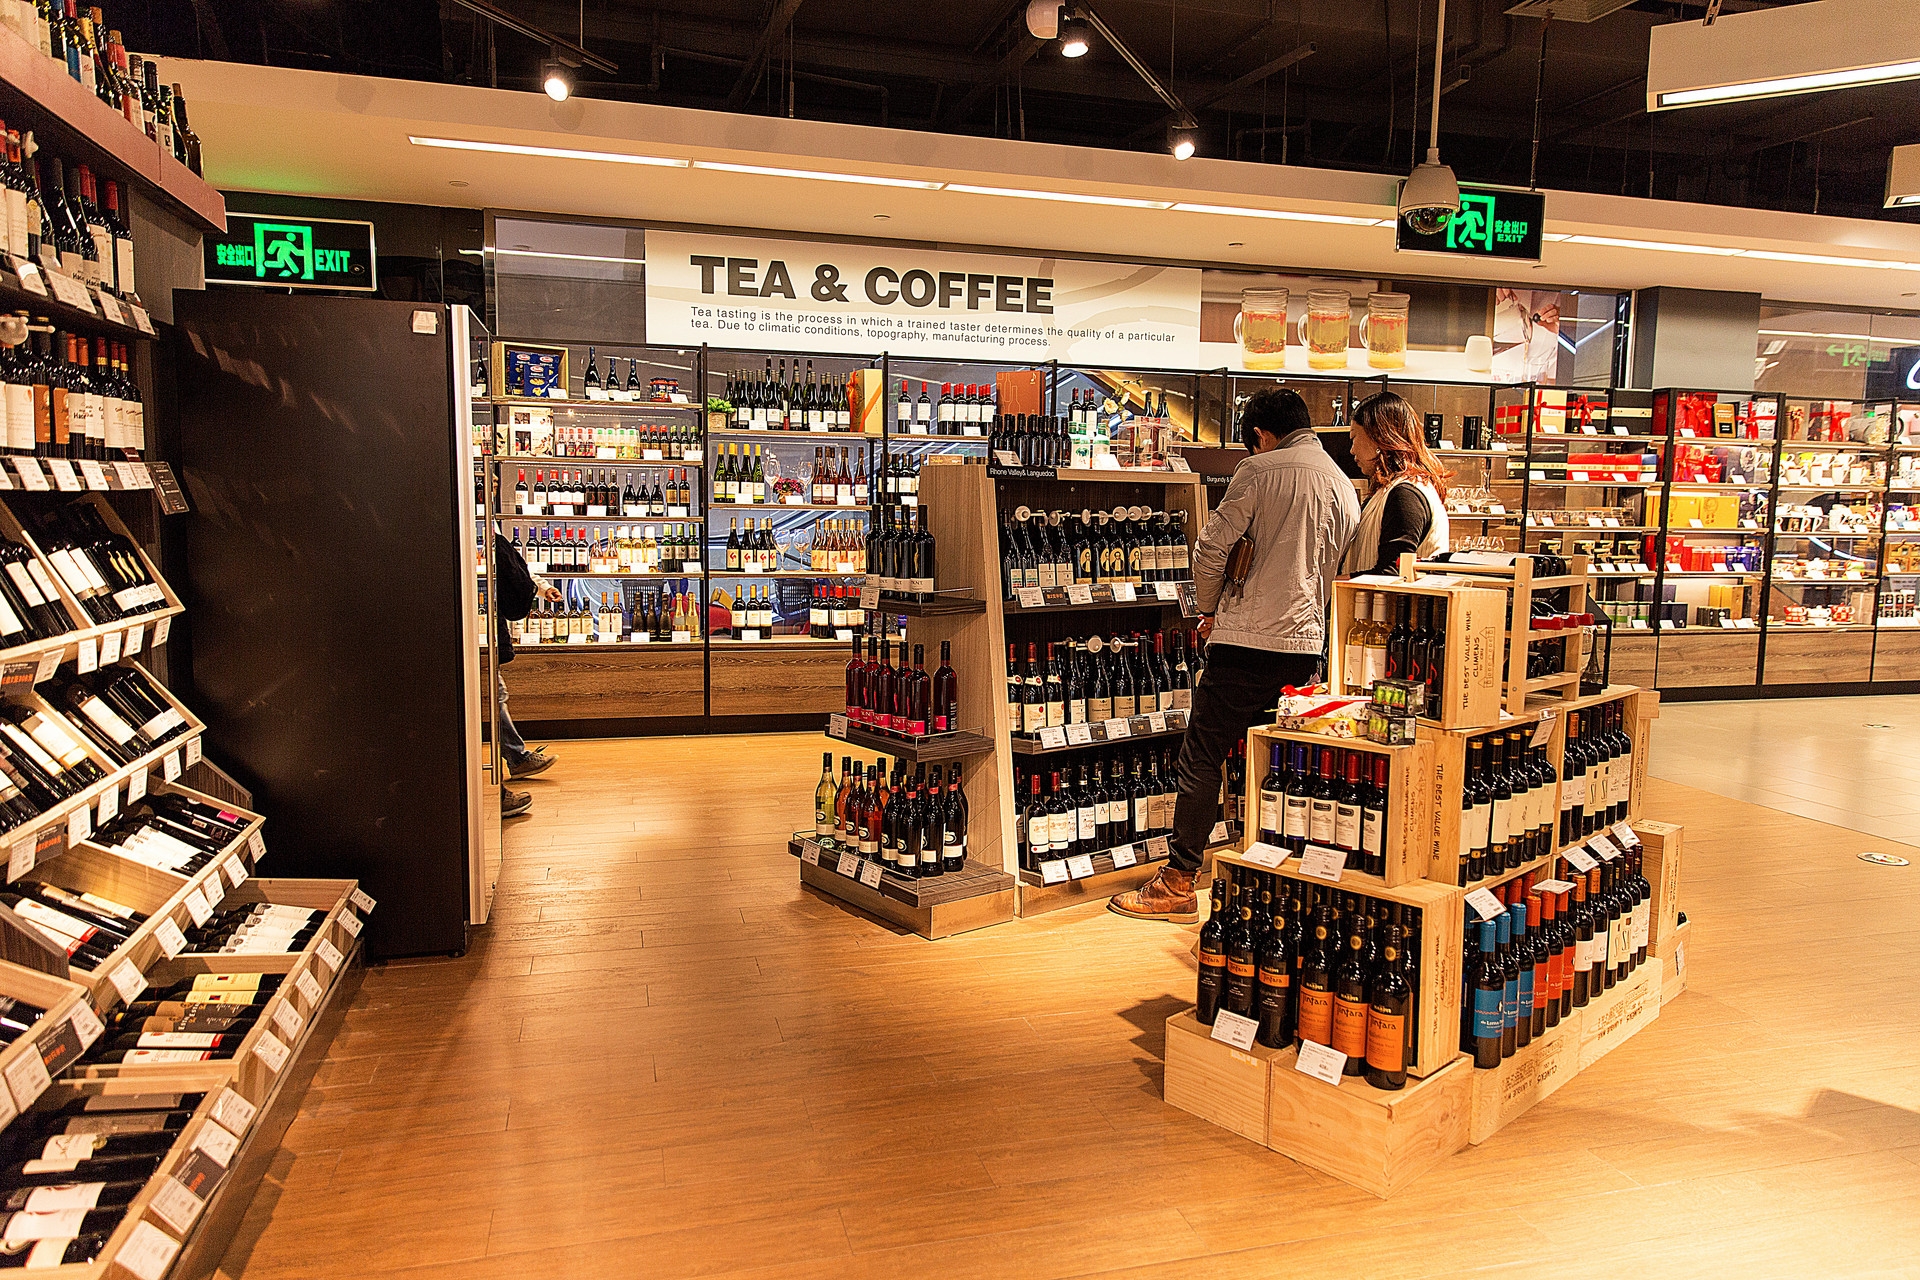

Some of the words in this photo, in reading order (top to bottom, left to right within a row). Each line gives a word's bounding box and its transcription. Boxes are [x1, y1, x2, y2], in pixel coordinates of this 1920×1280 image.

[1495, 220, 1528, 235] 安全出口
[1497, 234, 1524, 243] EXIT
[216, 243, 255, 267] 安全出口
[315, 249, 350, 273] EXIT
[690, 255, 796, 299] TEA
[811, 264, 849, 302] &
[864, 266, 1054, 315] COFFEE
[691, 307, 711, 317] Tea
[716, 308, 756, 321] tasting
[761, 311, 771, 320] is
[775, 311, 793, 322] the
[797, 314, 842, 327] process
[847, 316, 857, 325] in
[861, 318, 893, 327] which
[896, 320, 903, 328] a
[907, 319, 945, 331] trained
[949, 321, 981, 332] taster
[984, 323, 1044, 337] determines
[1047, 327, 1063, 337] the
[1067, 328, 1102, 341] quality
[1105, 329, 1115, 339] of
[1118, 332, 1124, 340] a
[1127, 332, 1175, 344] particular
[691, 318, 713, 329] tea.
[717, 319, 740, 330] Due
[744, 321, 755, 331] to
[759, 321, 801, 334] climatic
[804, 325, 862, 338] conditions,
[867, 327, 928, 341] topography,
[932, 331, 1005, 346] manufacturing
[1008, 336, 1050, 346] process.
[1027, 469, 1055, 478] Languedoc
[1436, 763, 1444, 781] THE
[1433, 810, 1441, 838] VALUE
[1432, 840, 1440, 861] WINE
